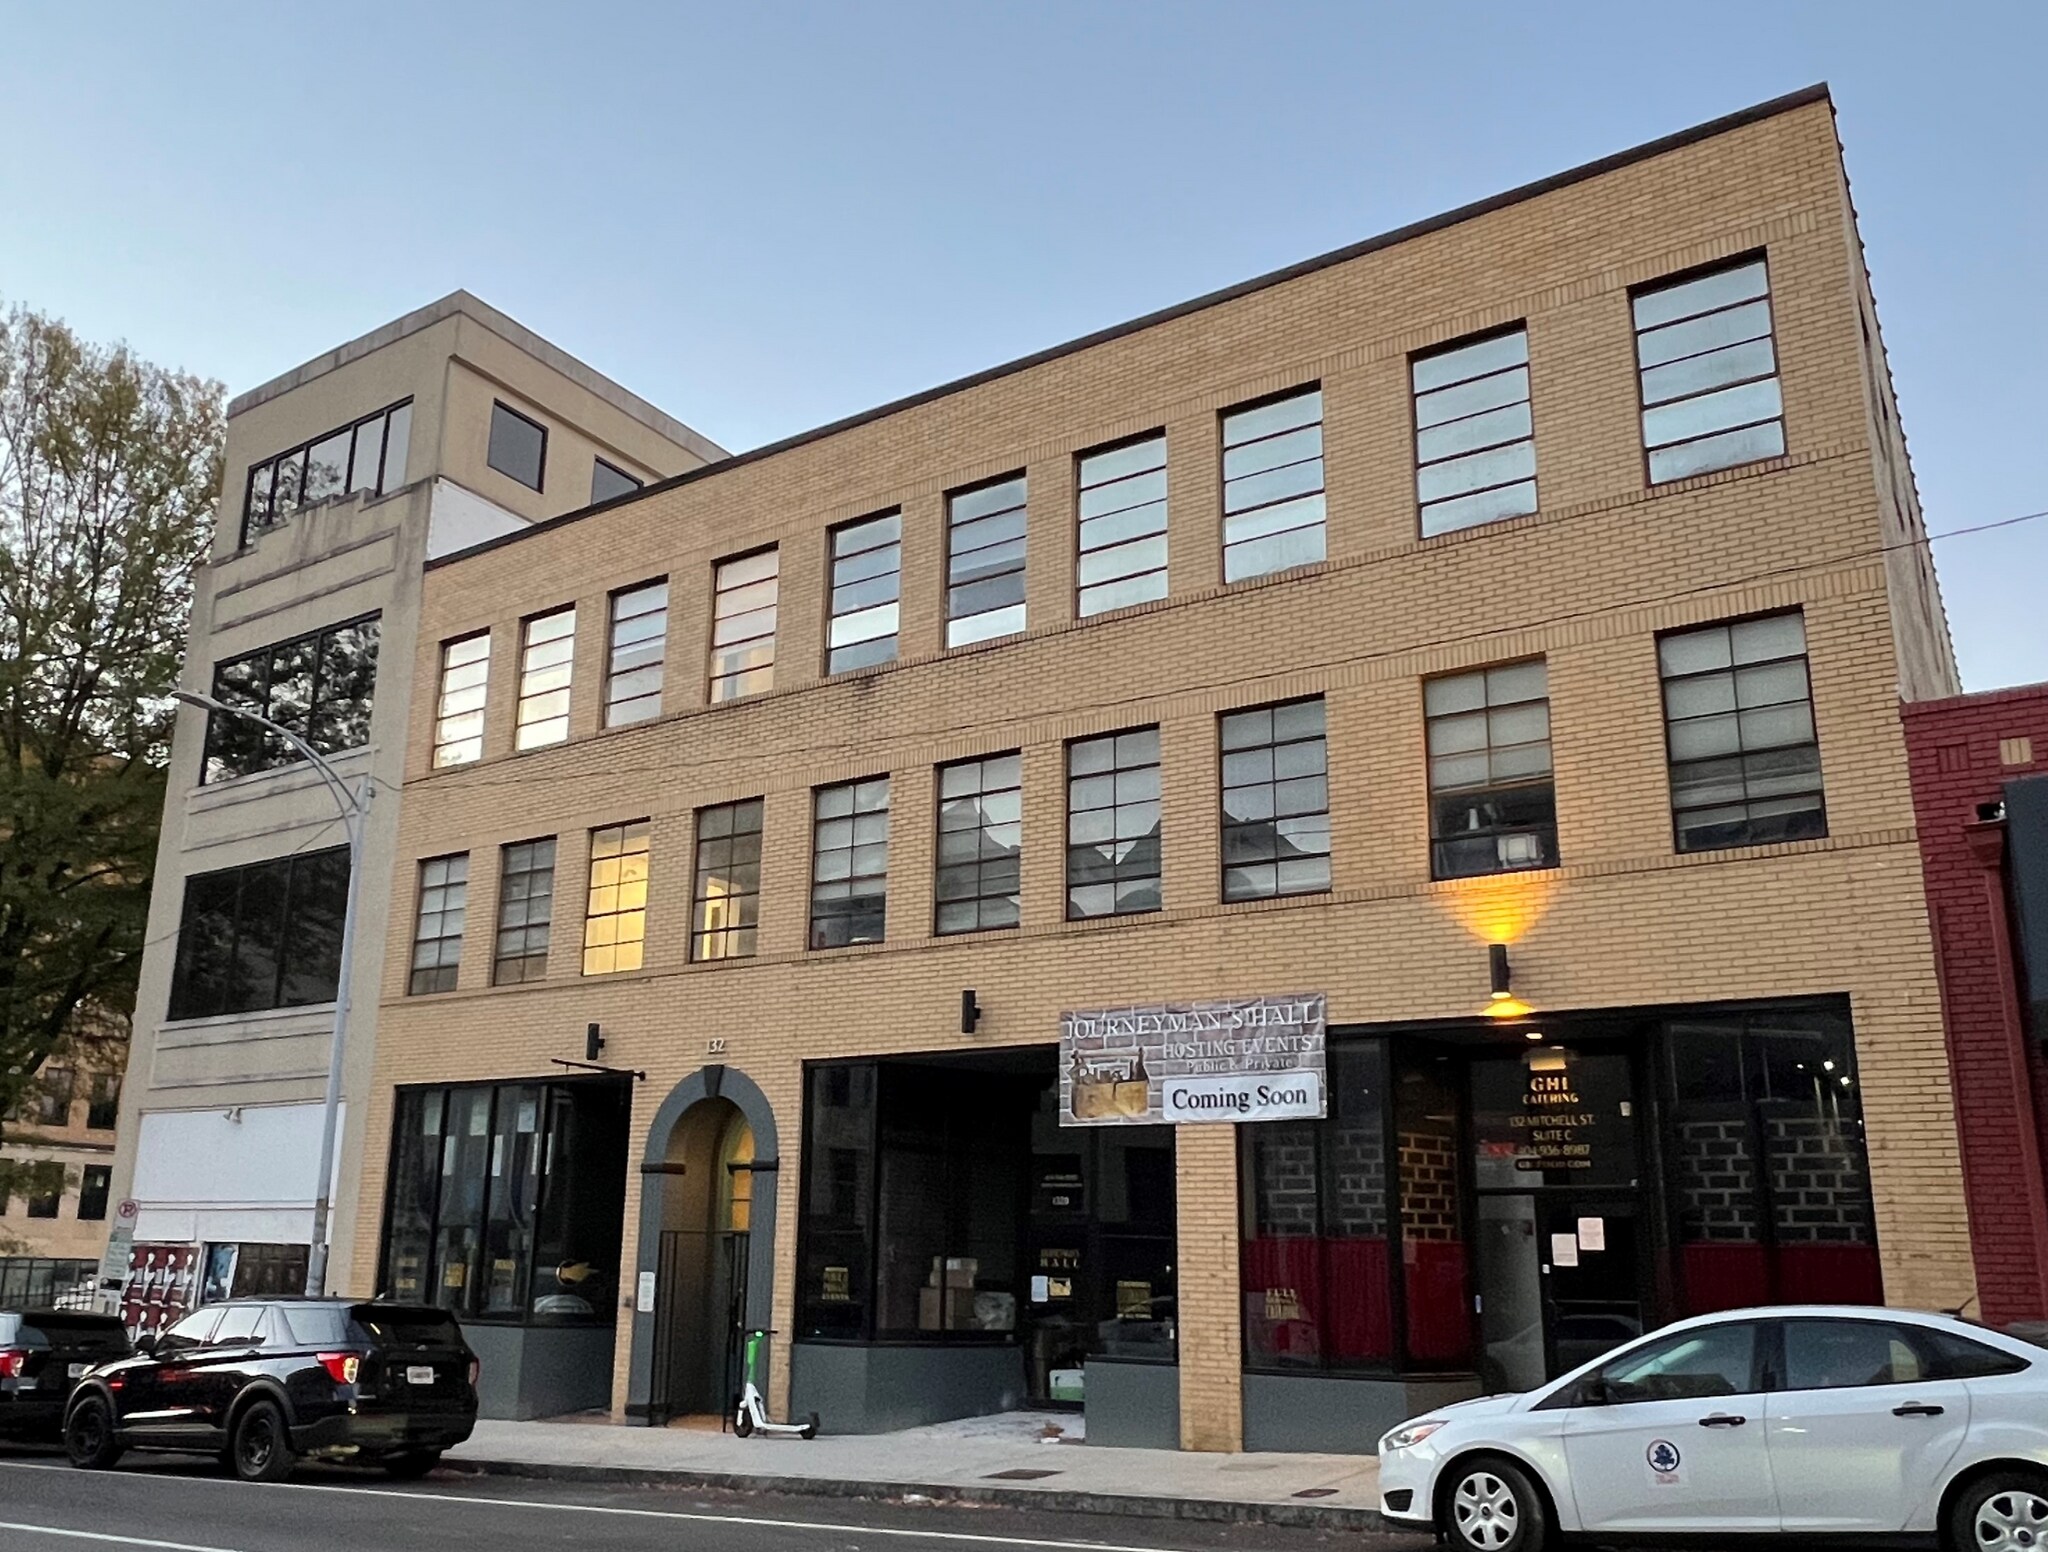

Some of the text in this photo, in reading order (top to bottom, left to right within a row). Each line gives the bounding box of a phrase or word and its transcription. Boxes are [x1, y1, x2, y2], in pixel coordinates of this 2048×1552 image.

[1249, 1003, 1320, 1027] HALL
[706, 1037, 725, 1053] 132
[1163, 1035, 1312, 1059] HOSTING EVENTS
[1187, 1059, 1228, 1073] Public
[1245, 1056, 1293, 1070] Private
[1530, 1076, 1569, 1092] GHI
[1172, 1085, 1307, 1113] Coming Soon
[1522, 1092, 1580, 1105] CATERING
[1527, 1114, 1578, 1127] MITCHELL
[1532, 1129, 1573, 1141] SUITE C
